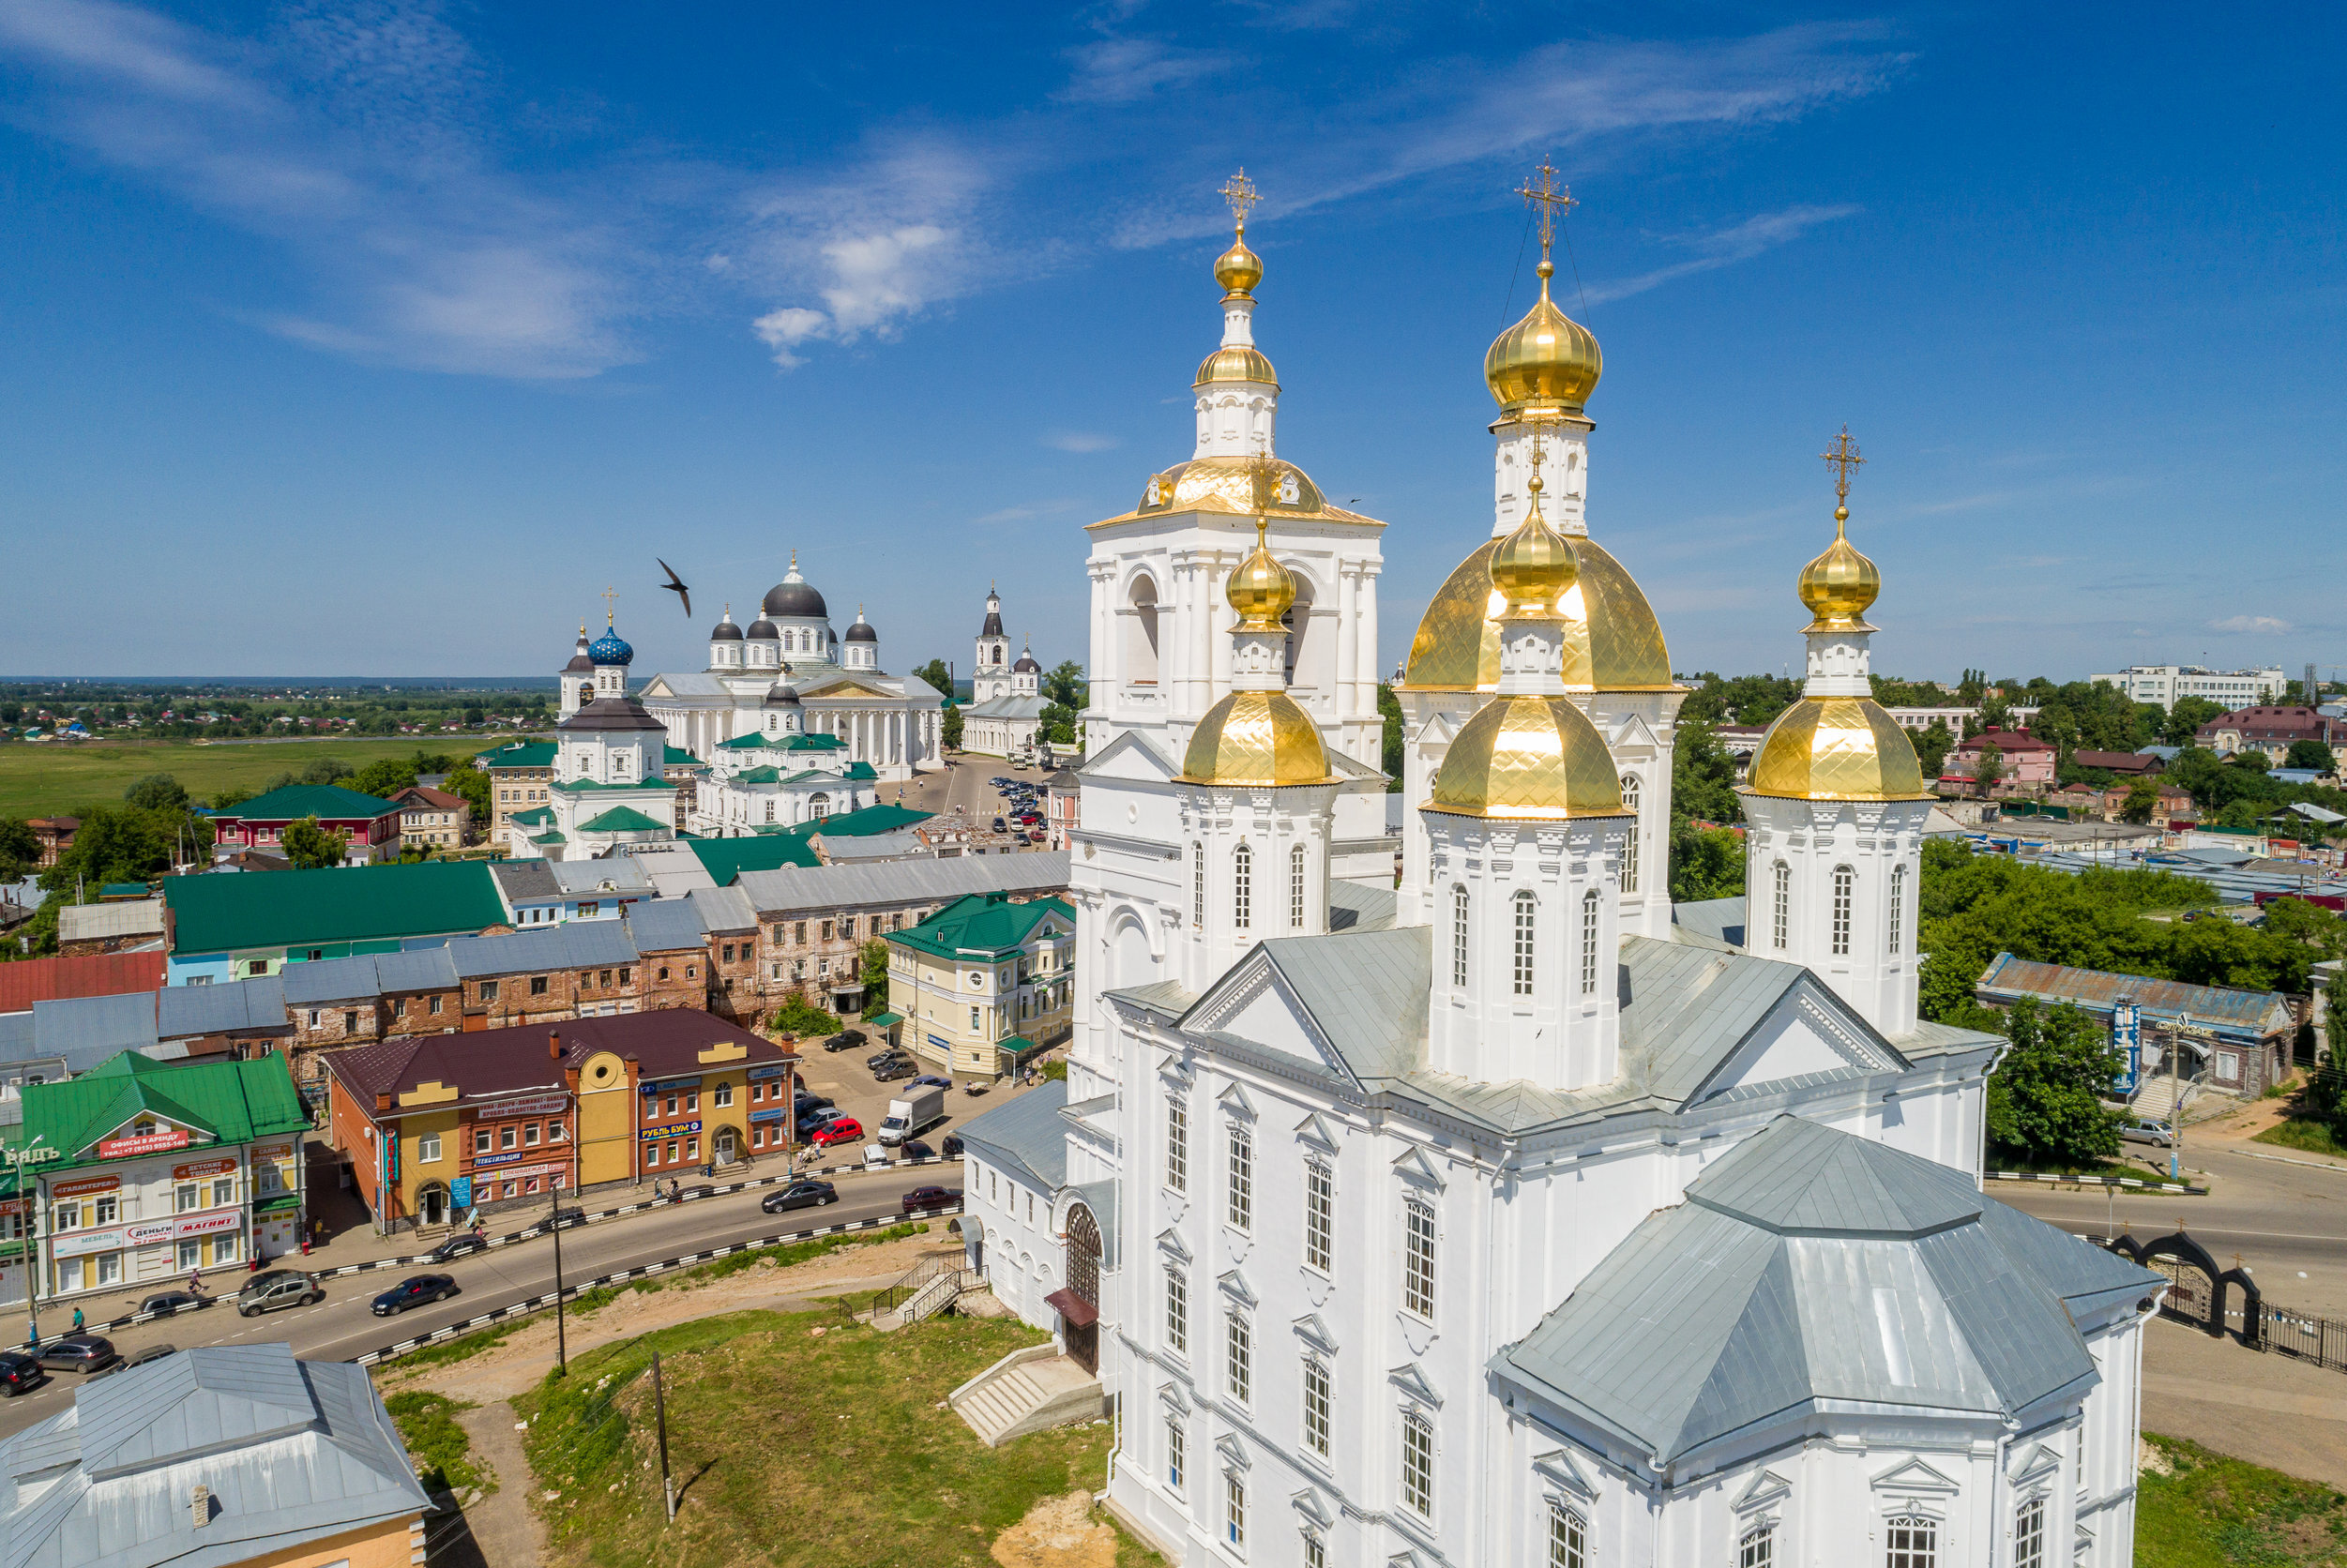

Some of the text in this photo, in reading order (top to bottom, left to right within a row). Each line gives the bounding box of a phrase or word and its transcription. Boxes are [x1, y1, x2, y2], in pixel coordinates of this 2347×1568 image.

[642, 1123, 689, 1138] РУБЛЬ БУМ
[111, 1139, 141, 1149] ОФИСЫ
[148, 1133, 179, 1143] АРЕНДУ
[134, 1144, 153, 1153] (915)
[153, 1139, 186, 1149] 9555-146
[6, 1147, 61, 1166] РЯДЪ
[253, 1153, 286, 1163] КРАСОТЫ
[386, 1138, 396, 1181] АПТЕКА
[477, 1153, 522, 1165] ТЕКСТИЛЬЩИК
[188, 1161, 222, 1171] ДЕТСКИЕ
[502, 1166, 546, 1176] СПЕЦОДЕЖДА
[189, 1168, 221, 1177] ТОВАРЫ
[62, 1181, 112, 1193] ГАЛАНТЕРЕЯ
[181, 1218, 233, 1231] МАГНИТ
[136, 1226, 173, 1237] ДЕНЬГИ
[82, 1233, 114, 1244] МЕБЕЛЬ
